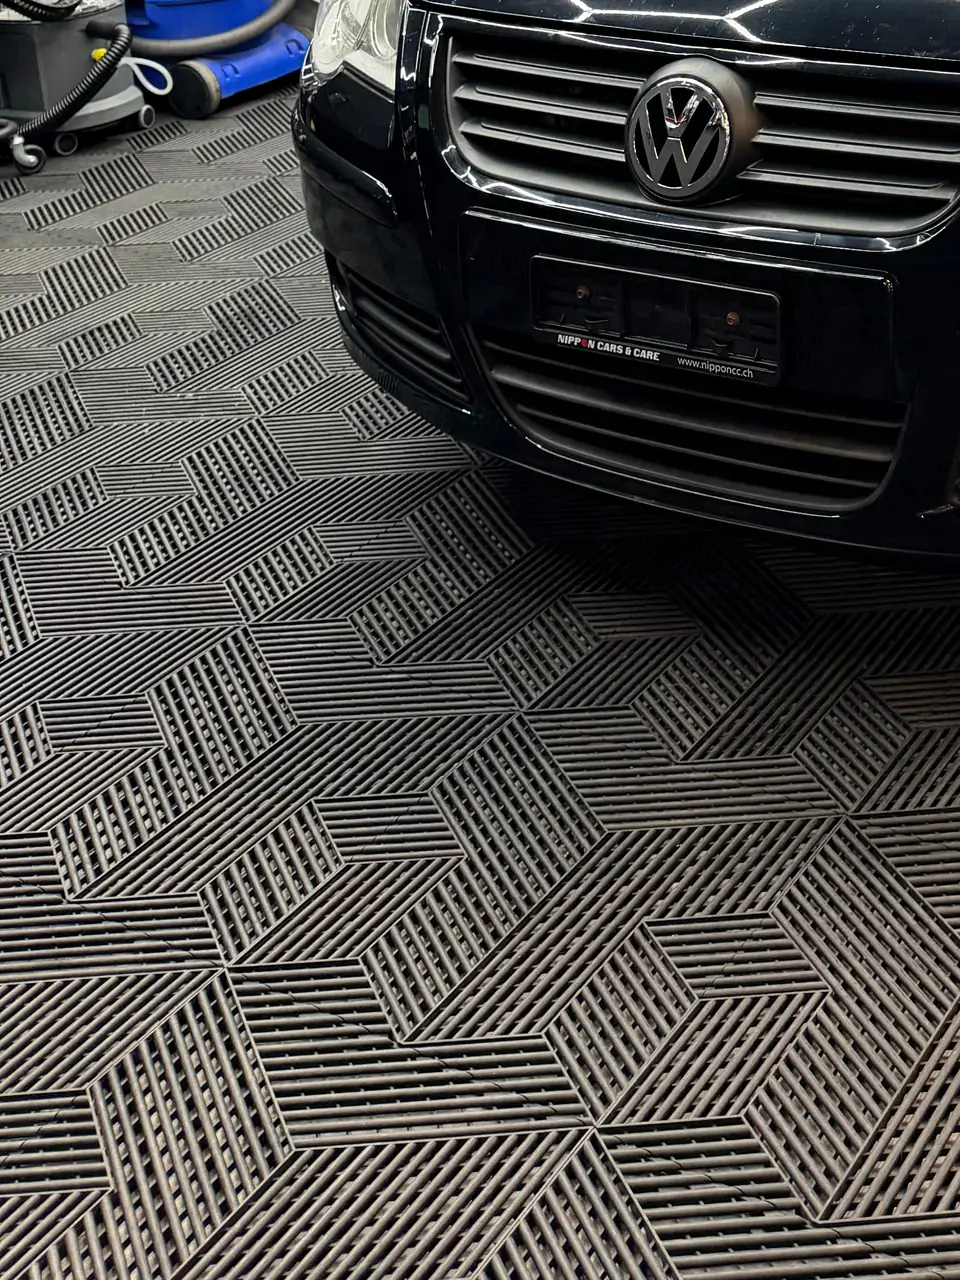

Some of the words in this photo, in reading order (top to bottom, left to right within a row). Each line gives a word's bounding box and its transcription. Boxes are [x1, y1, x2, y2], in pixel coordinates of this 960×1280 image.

[629, 76, 730, 198] VW
[557, 334, 596, 349] NIPPON
[596, 341, 624, 355] CARS
[624, 346, 632, 356] &
[633, 348, 660, 362] CARE
[677, 357, 754, 379] www.nipponcc.ch
